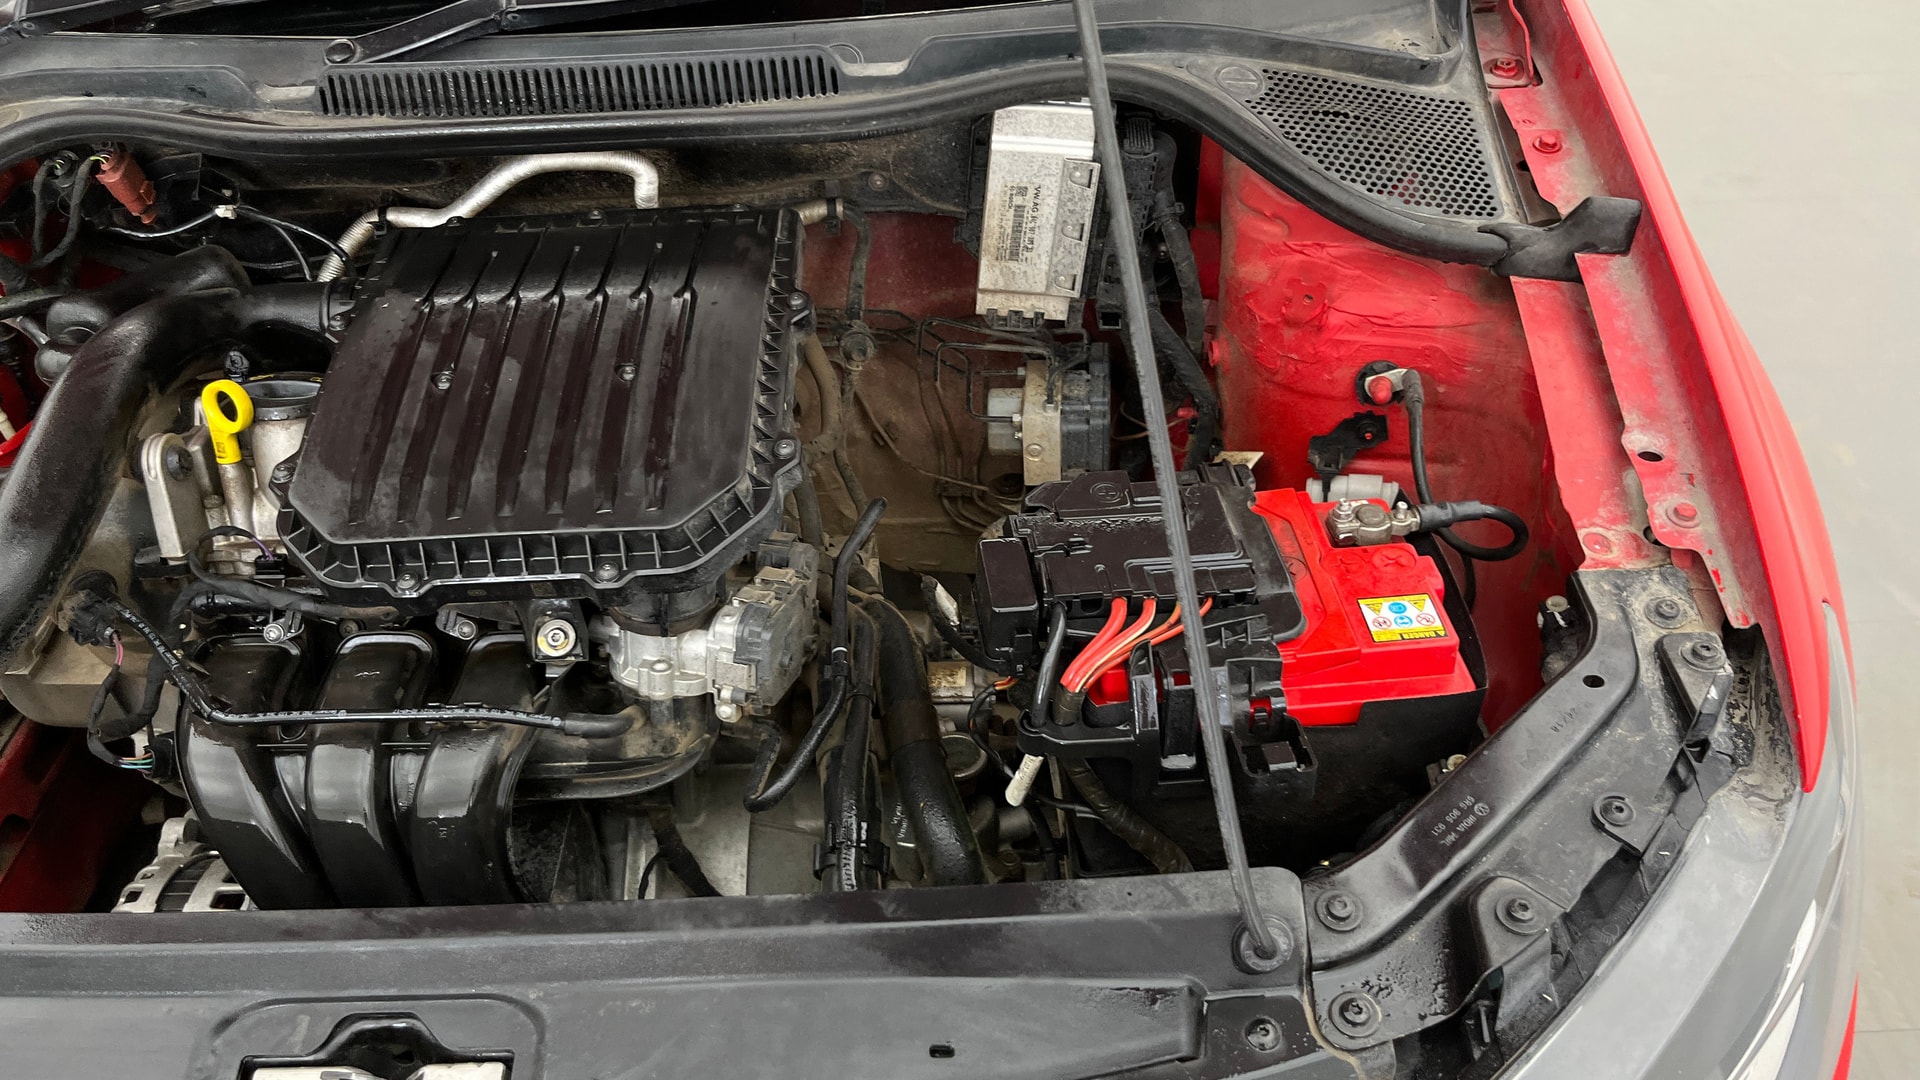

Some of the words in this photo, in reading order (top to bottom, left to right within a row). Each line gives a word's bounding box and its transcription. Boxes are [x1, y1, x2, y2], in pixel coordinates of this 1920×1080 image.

[1032, 185, 1041, 199] VW
[1031, 201, 1039, 213] AG
[1402, 631, 1435, 639] DANGER
[1456, 814, 1476, 831] INDIA
